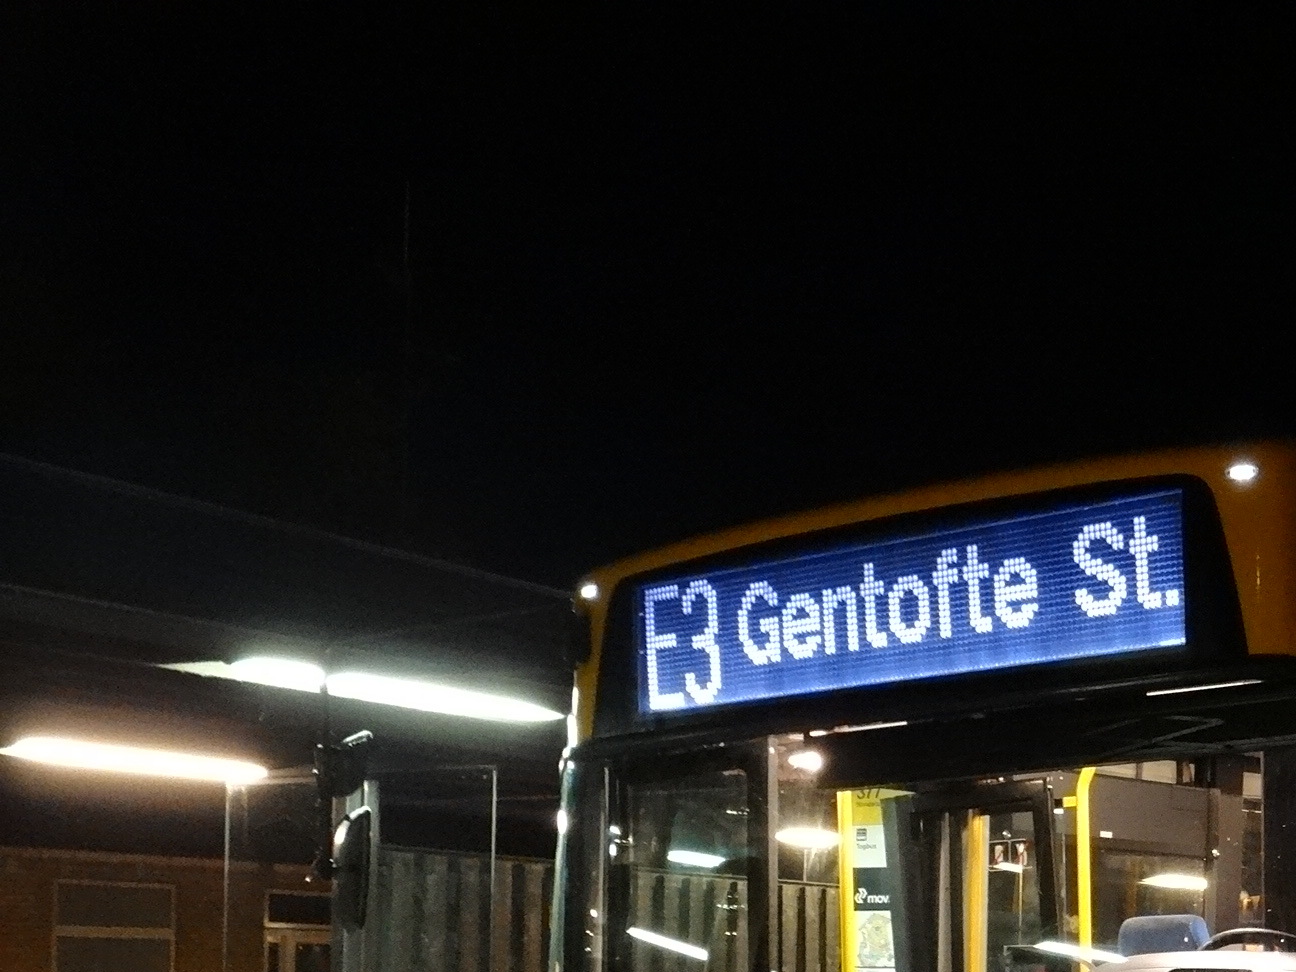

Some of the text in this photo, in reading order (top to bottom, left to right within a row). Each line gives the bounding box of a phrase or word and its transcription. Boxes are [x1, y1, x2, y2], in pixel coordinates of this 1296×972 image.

[644, 516, 1180, 711] E3 Gentofte St.
